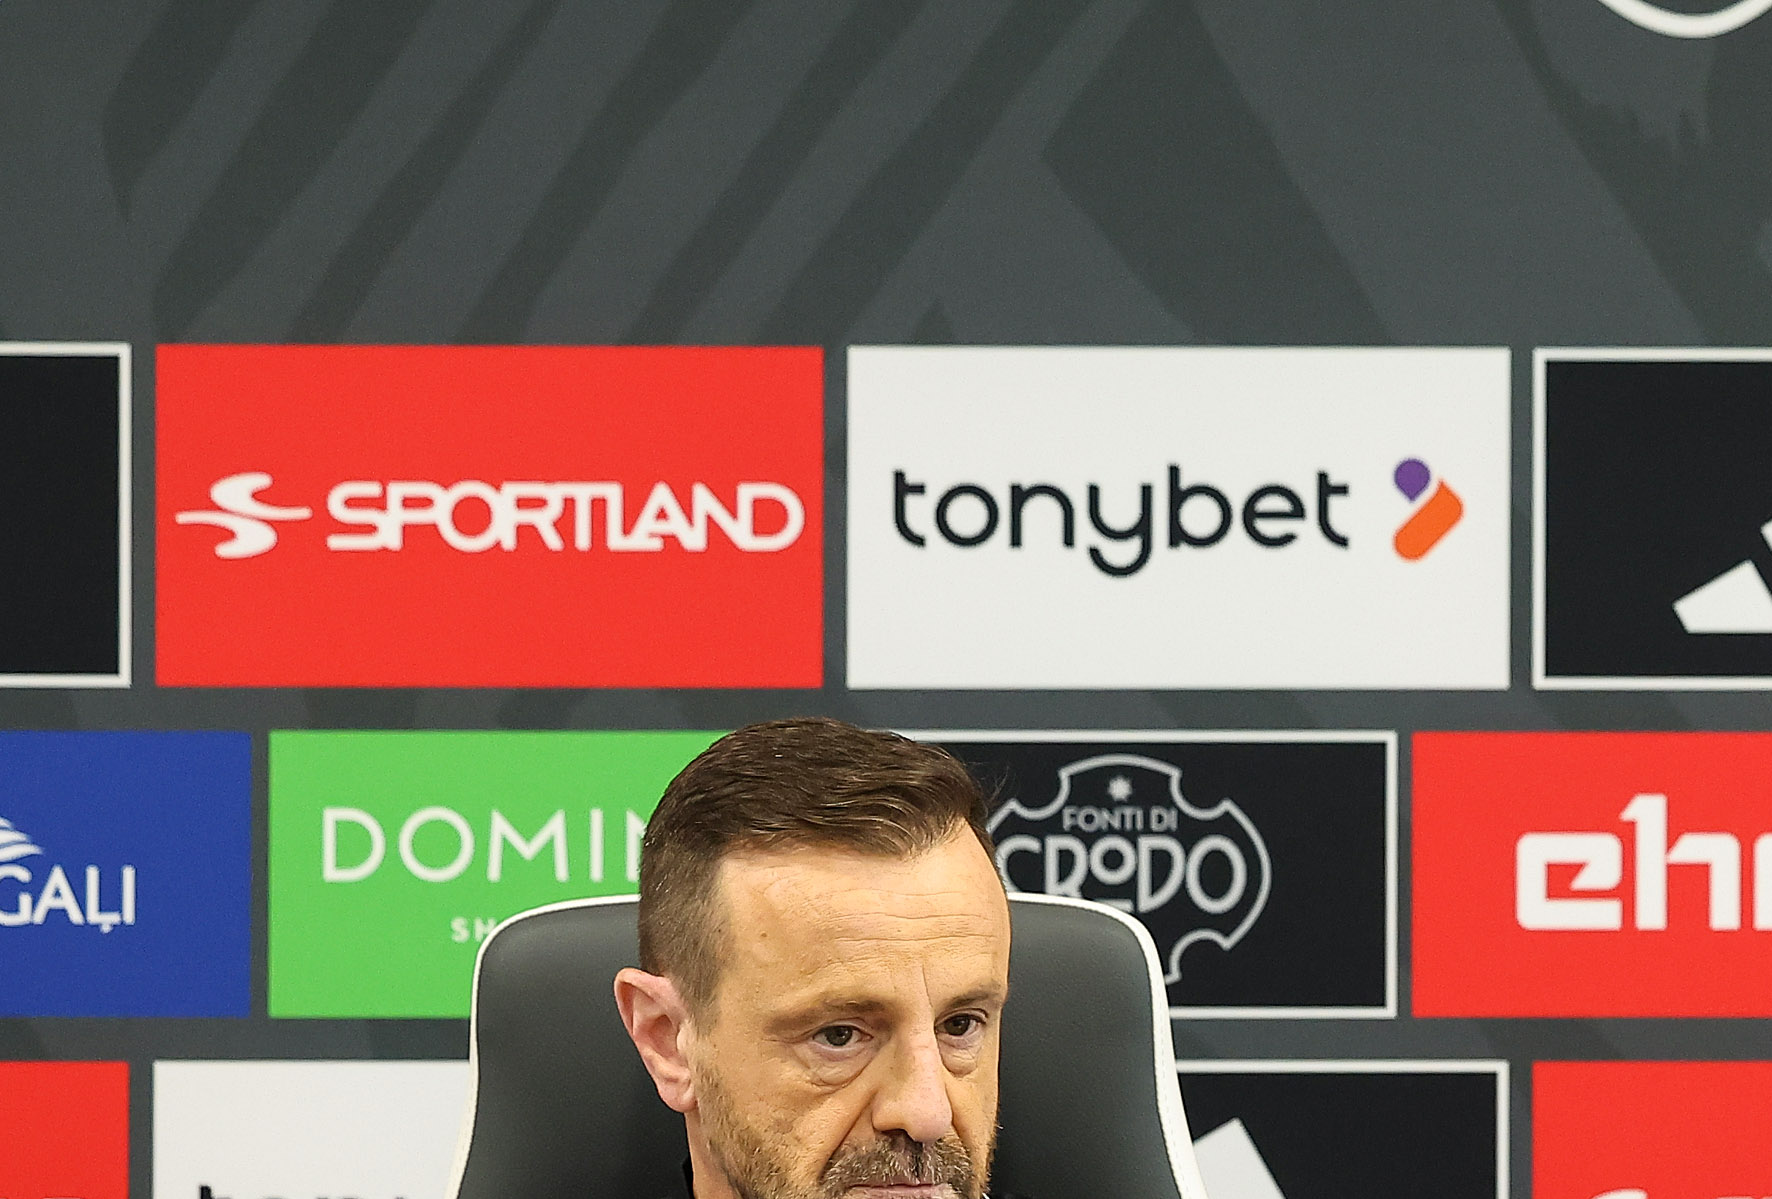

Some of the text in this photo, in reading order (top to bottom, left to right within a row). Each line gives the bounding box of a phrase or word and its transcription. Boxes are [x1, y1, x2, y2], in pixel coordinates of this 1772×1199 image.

[326, 480, 805, 553] SPORTLAND
[892, 463, 1350, 579] tonybet
[1062, 805, 1179, 832] FONTI DI
